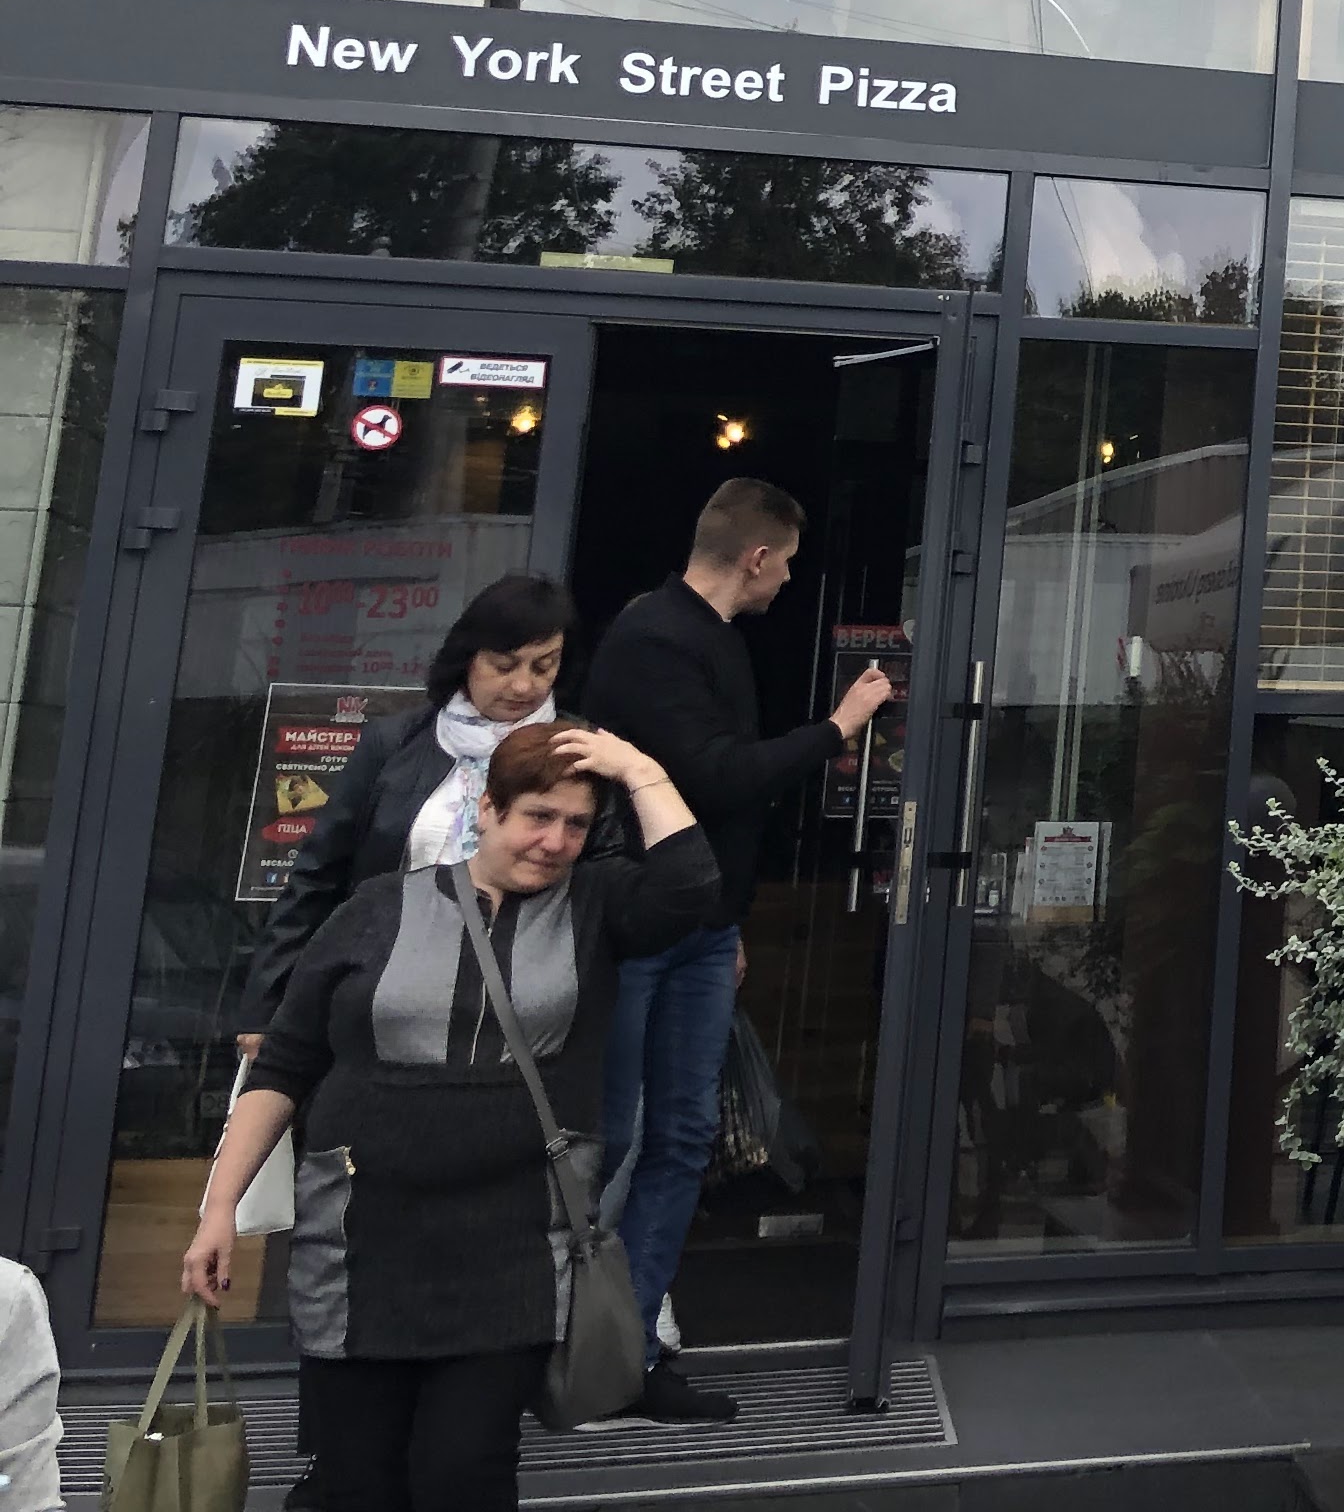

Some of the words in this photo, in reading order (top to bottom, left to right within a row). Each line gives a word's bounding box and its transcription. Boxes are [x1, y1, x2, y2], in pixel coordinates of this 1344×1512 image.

[286, 23, 419, 74] New
[451, 34, 581, 85] York
[619, 51, 787, 103] Street
[816, 65, 959, 114] Pizza
